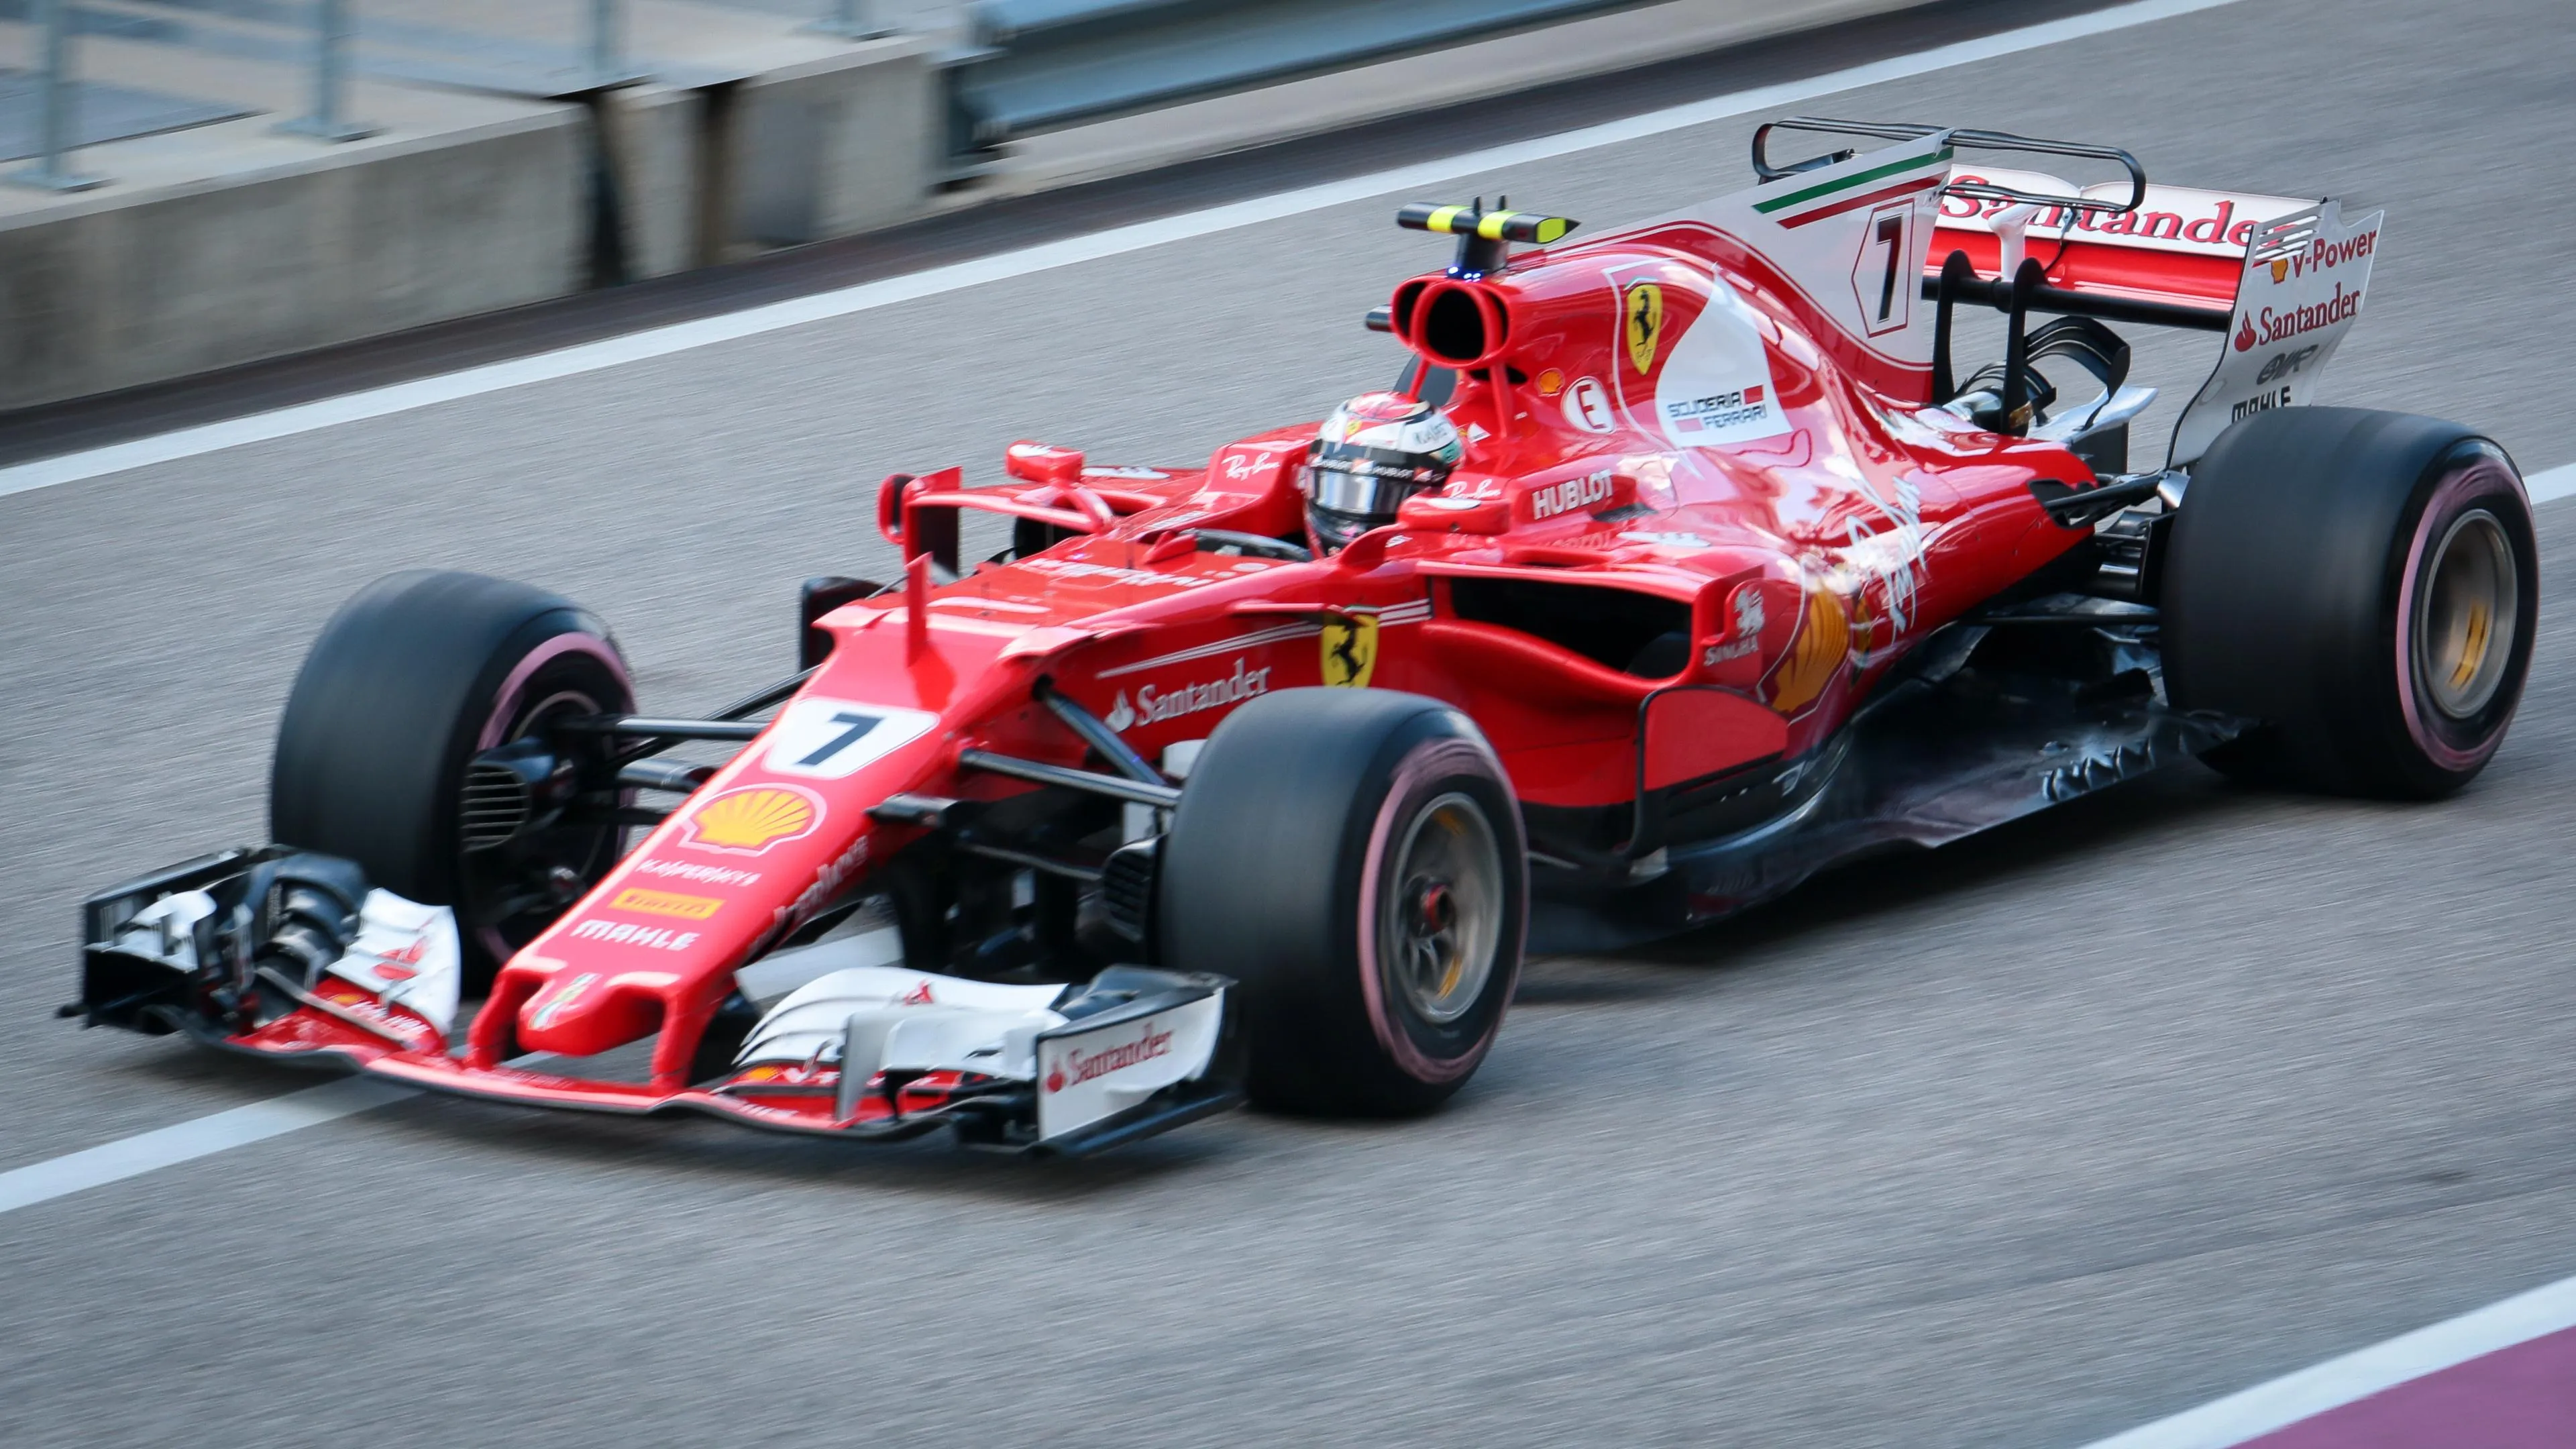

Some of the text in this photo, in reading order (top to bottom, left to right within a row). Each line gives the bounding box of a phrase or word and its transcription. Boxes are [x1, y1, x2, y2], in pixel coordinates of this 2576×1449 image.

[1877, 213, 1904, 323] 7
[2292, 229, 2377, 278] V-Power
[2259, 282, 2360, 345] Santander
[1668, 391, 1742, 417] SCUDERIA
[1703, 404, 1767, 428] FERRARI
[1532, 469, 1613, 520] HUBLOT
[1136, 657, 1271, 727] Santander
[794, 712, 885, 766] 7
[570, 919, 701, 951] MAHLE
[1069, 1020, 1173, 1087] Santander
